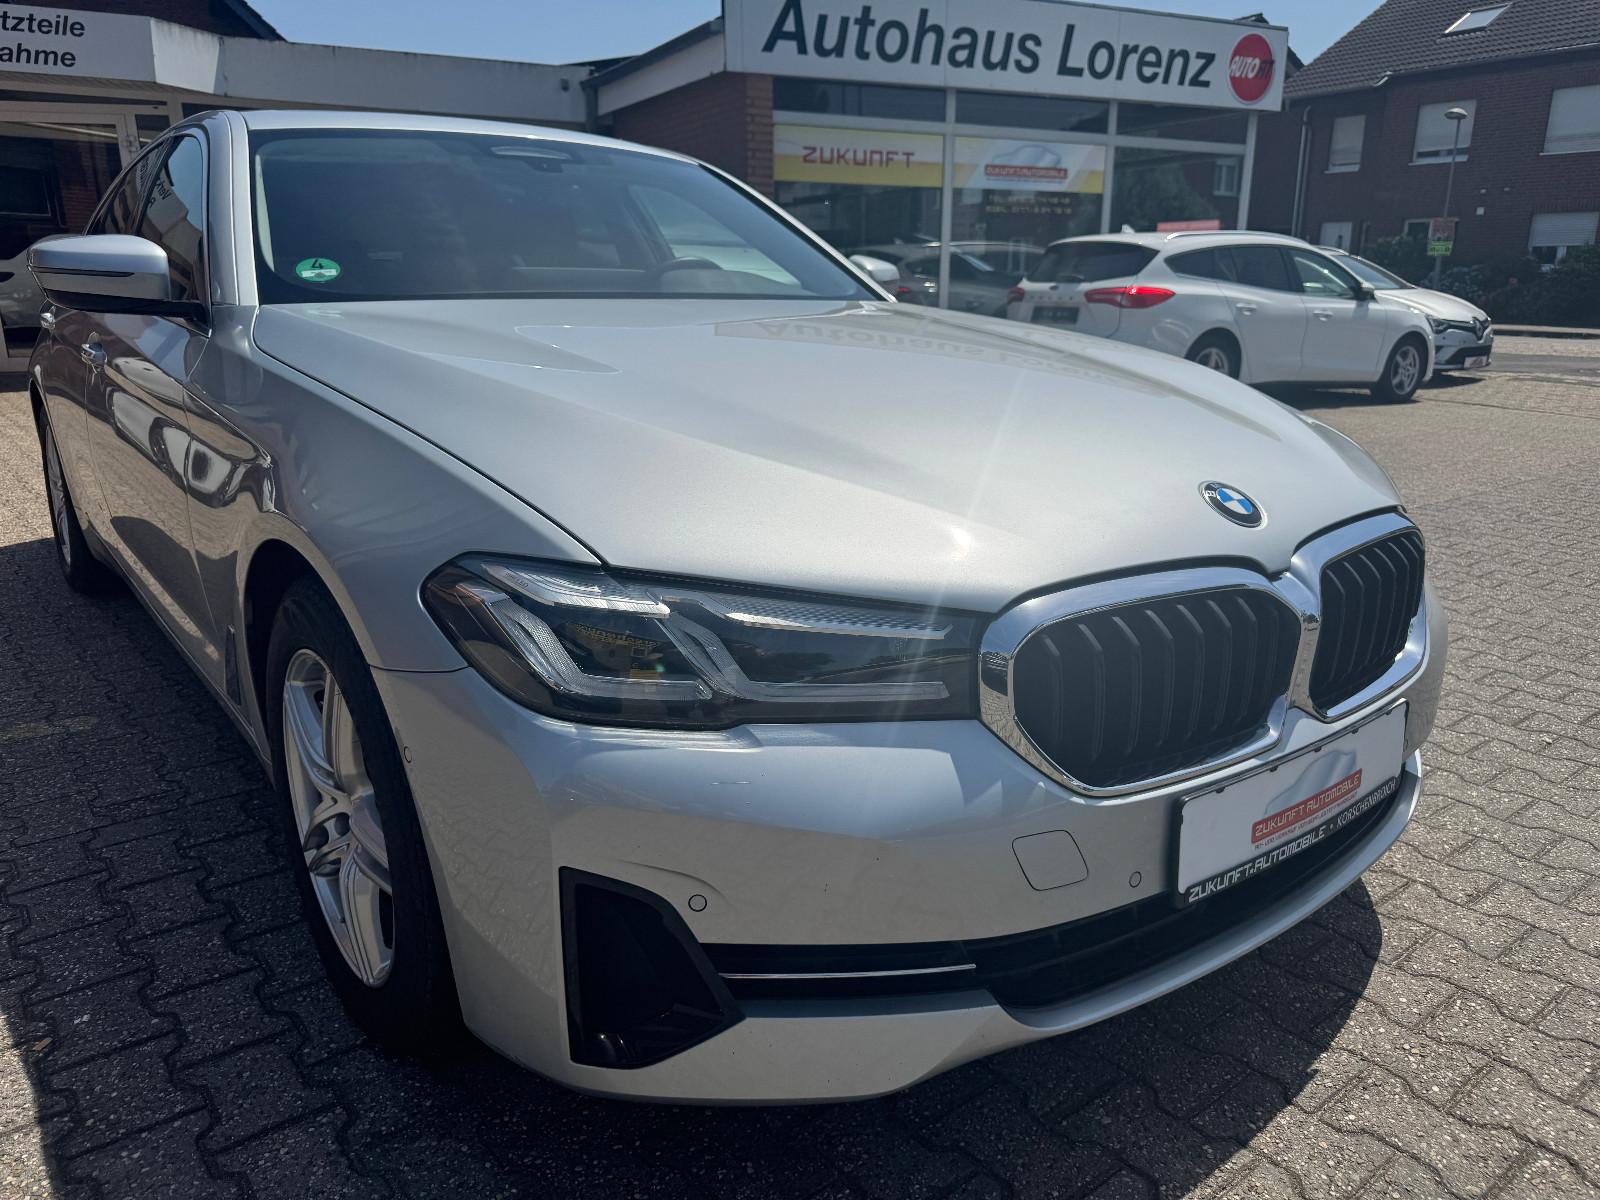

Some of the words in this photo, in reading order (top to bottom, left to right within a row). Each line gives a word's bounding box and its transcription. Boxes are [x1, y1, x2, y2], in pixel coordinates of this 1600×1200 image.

[0, 11, 85, 37] tzteile
[0, 43, 76, 67] ahme
[761, 0, 1042, 74] Autohaus
[1056, 23, 1216, 88] Lorenz
[802, 145, 915, 169] ZUKUNFT
[311, 259, 325, 269] 4
[1255, 804, 1305, 837] ZUKUNFT
[1306, 774, 1360, 814] AUTOMOBILE
